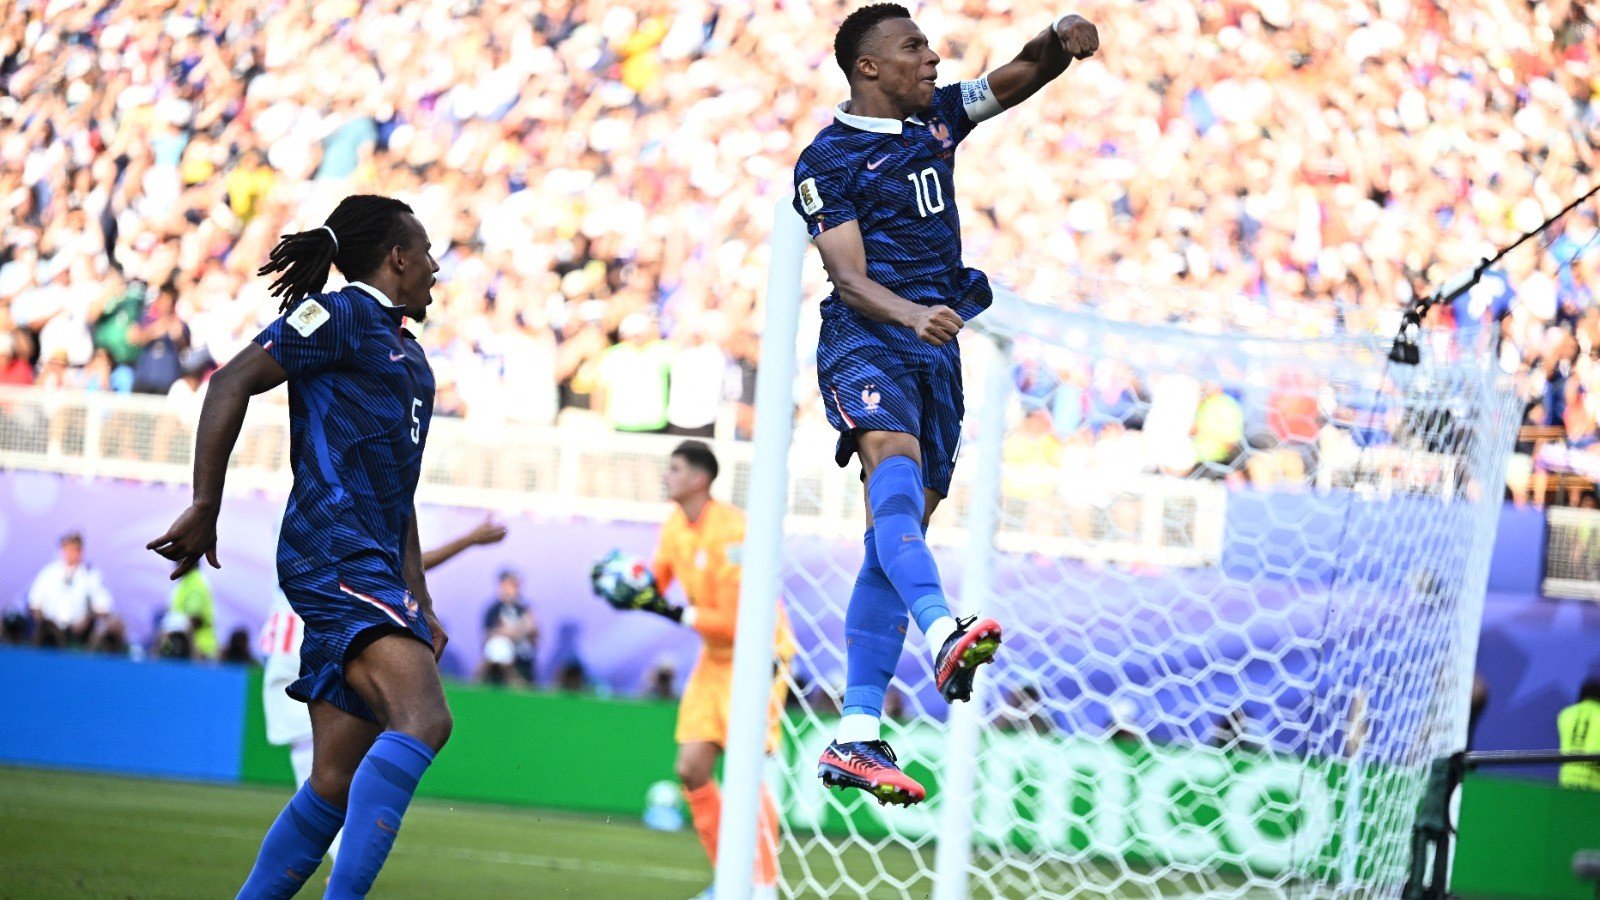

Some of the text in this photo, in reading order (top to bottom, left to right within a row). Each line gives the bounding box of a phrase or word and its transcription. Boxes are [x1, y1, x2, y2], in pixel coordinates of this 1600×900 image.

[907, 167, 945, 218] 10
[411, 397, 423, 445] 5
[766, 718, 1336, 868] ramco
